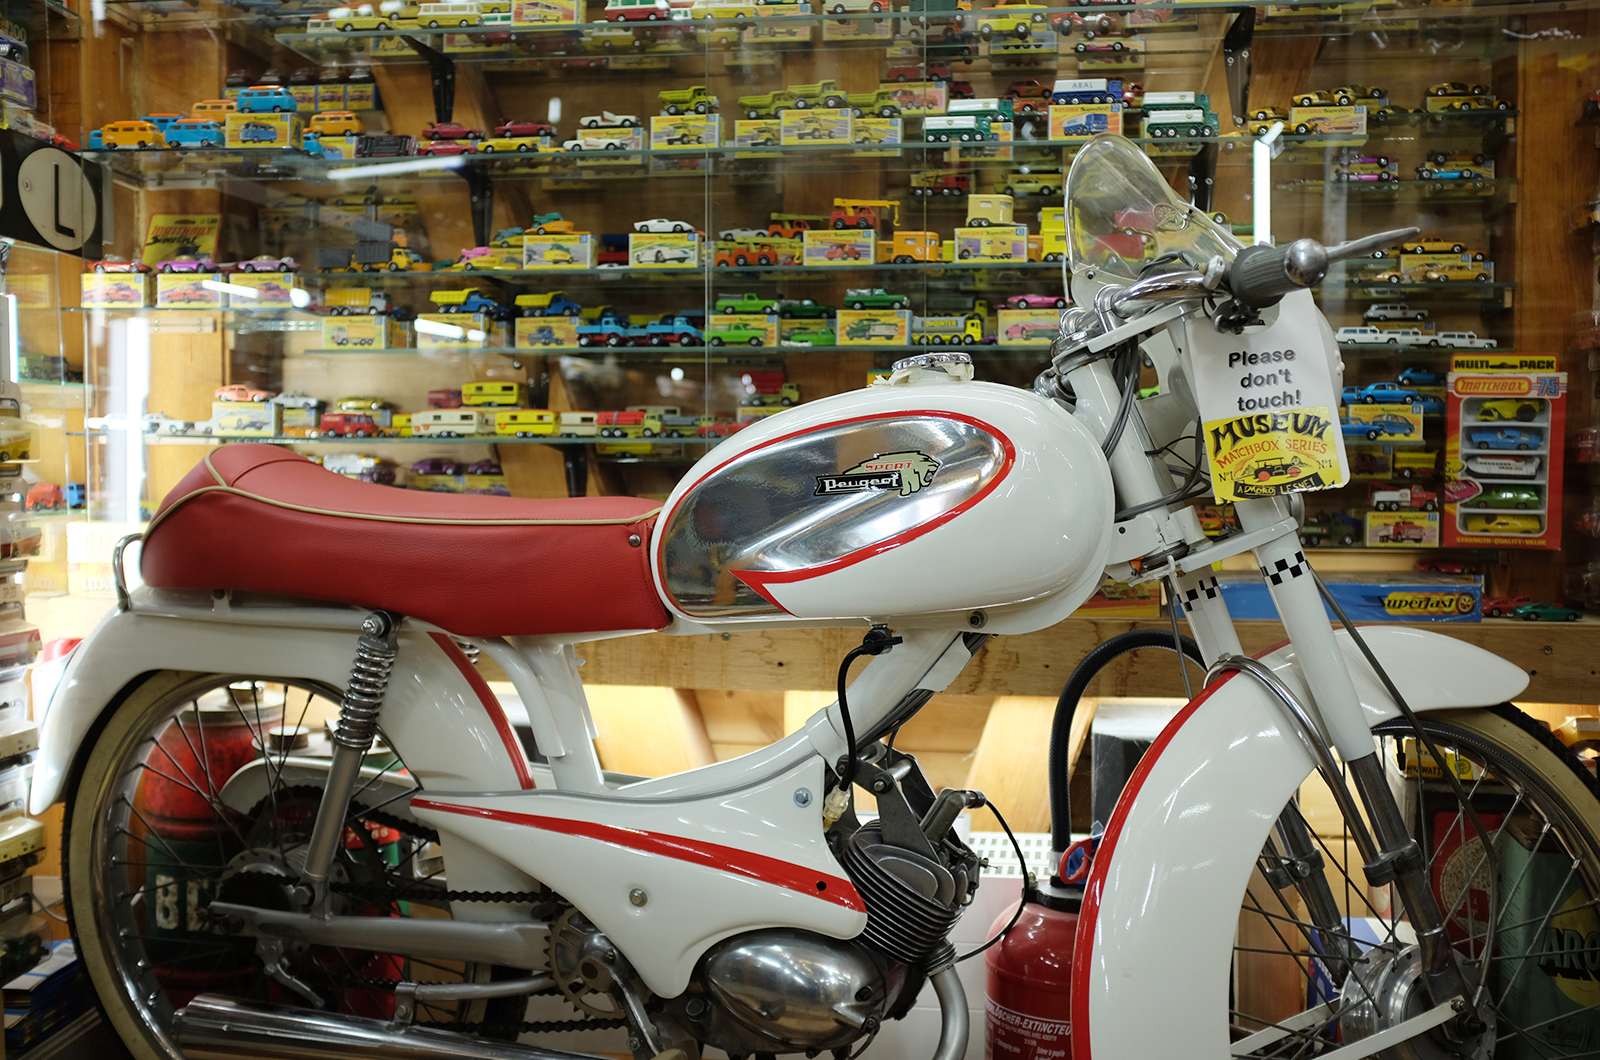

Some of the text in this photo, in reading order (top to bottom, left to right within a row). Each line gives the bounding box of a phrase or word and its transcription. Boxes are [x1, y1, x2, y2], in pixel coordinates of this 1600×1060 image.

[53, 161, 76, 239] L
[151, 225, 216, 237] MATCHBOX
[1228, 348, 1296, 369] Please
[1454, 360, 1555, 370] MULTI PACK
[1240, 368, 1293, 389] don't
[1460, 377, 1560, 396] MATCHBOX 75
[1237, 389, 1302, 412] touch!
[1210, 412, 1332, 459] MUSEUM
[1213, 439, 1328, 469] MATCHBOX SERIES
[865, 460, 913, 472] SPORT
[823, 473, 900, 492] Peugeot
[1279, 476, 1316, 495] LESNEY
